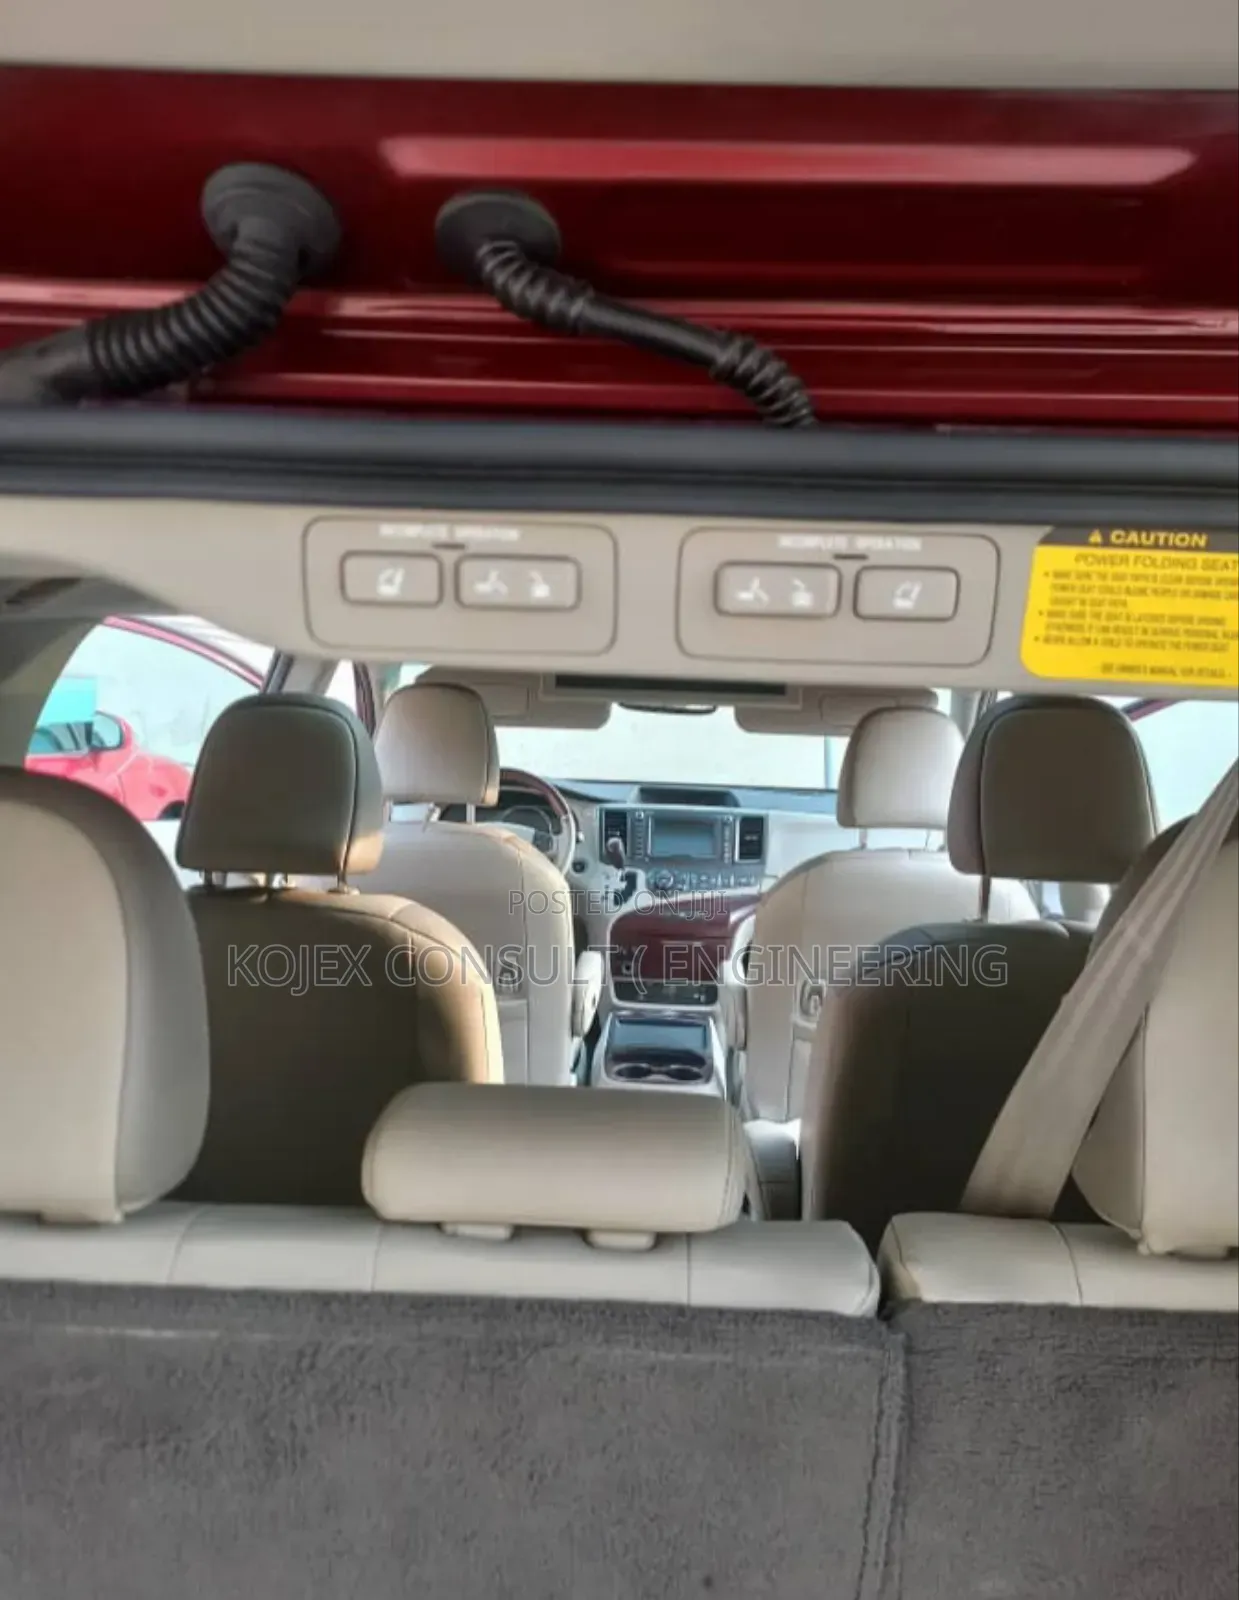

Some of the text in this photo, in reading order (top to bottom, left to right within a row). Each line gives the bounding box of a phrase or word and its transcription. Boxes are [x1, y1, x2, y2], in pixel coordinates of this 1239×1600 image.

[1111, 529, 1208, 548] CAUTION
[1074, 553, 1130, 567] POWER
[1133, 555, 1198, 570] FOLDING
